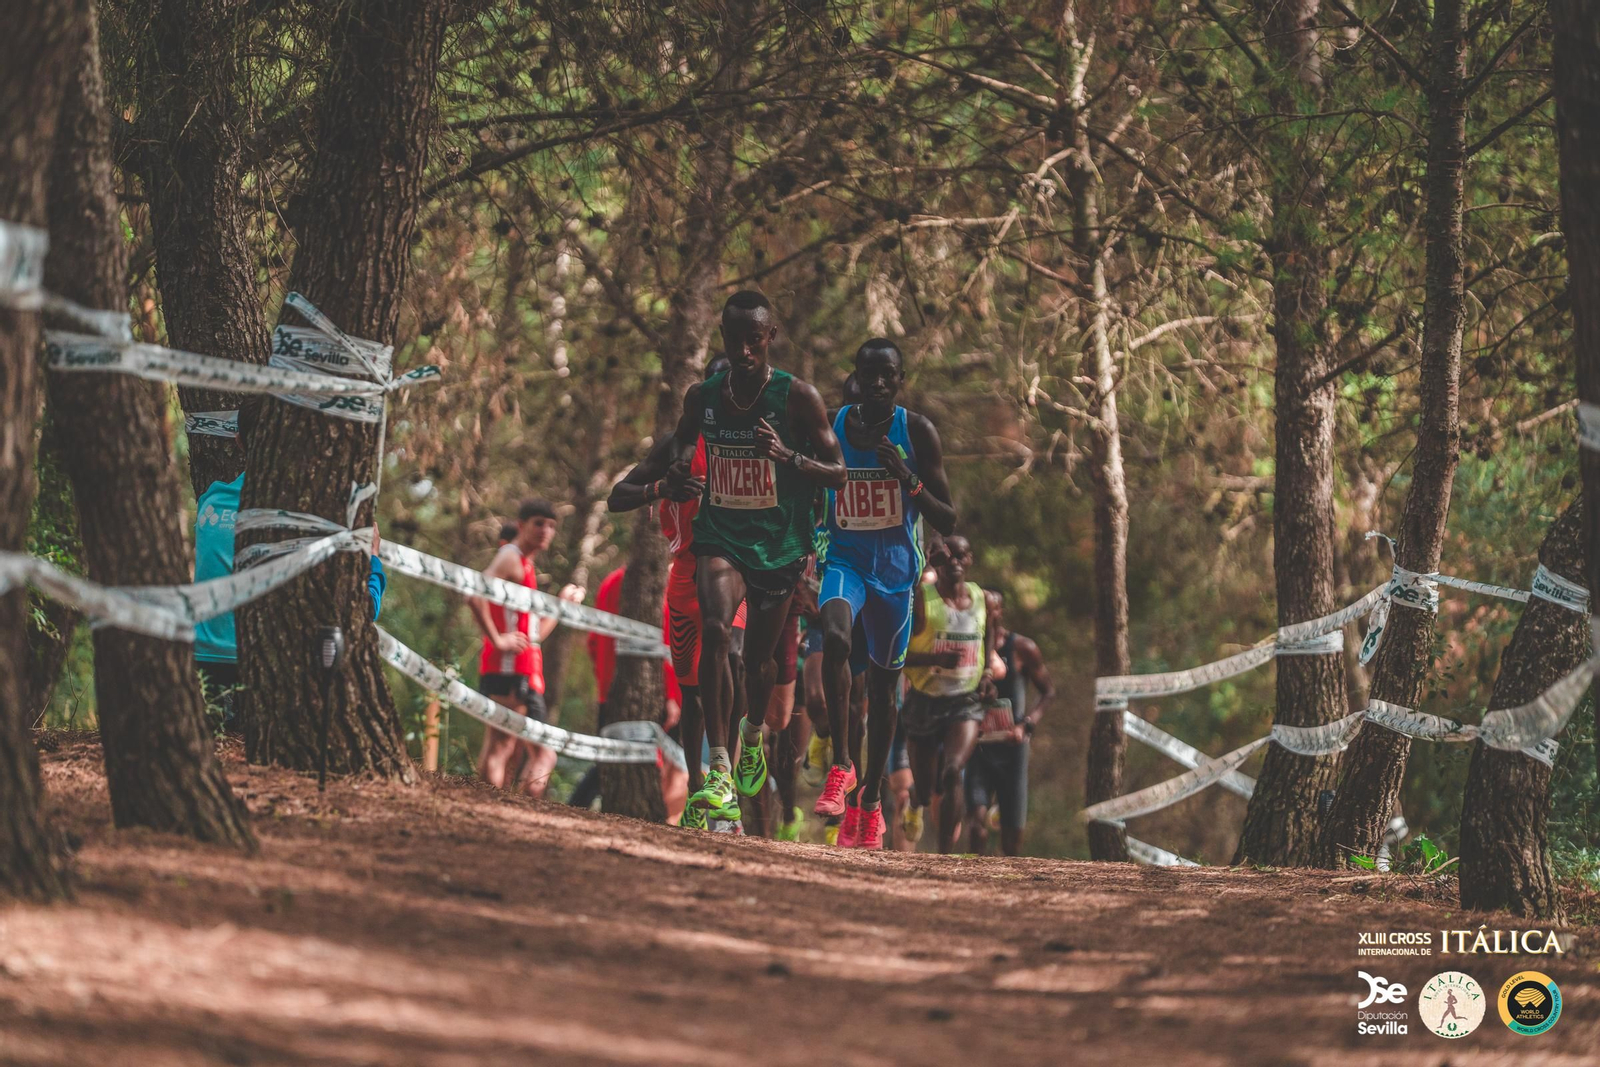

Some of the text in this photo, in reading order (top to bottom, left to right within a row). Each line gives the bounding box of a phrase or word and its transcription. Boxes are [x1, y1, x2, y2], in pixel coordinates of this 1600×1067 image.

[304, 349, 350, 366] Sevilla
[711, 455, 774, 497] KWIZERA
[836, 480, 899, 518] KIBET
